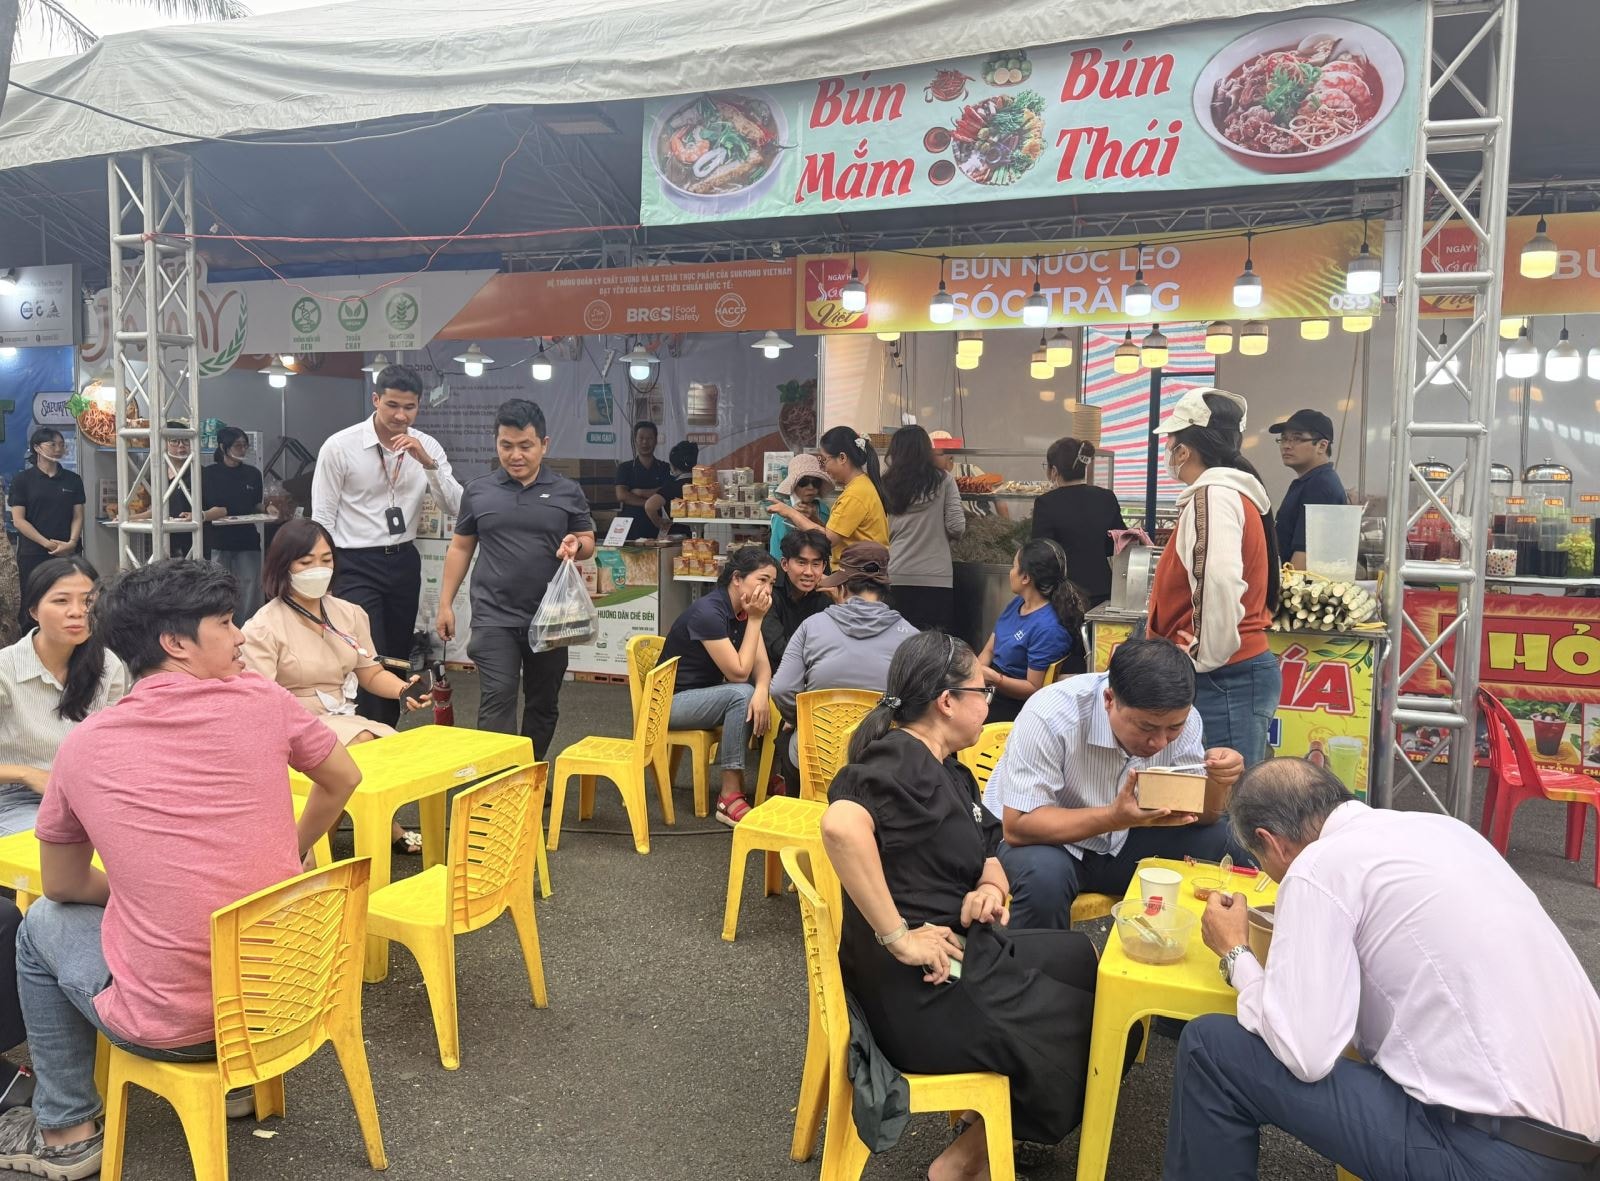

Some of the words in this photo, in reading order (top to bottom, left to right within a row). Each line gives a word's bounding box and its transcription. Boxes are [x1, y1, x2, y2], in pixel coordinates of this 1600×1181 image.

[1060, 39, 1175, 103] Bún
[810, 72, 907, 129] Bún
[1055, 118, 1183, 182] Thái
[795, 138, 915, 203] Mắm
[763, 267, 792, 276] VIETNAM
[951, 252, 1011, 280] BÚN
[675, 305, 696, 313] Food
[715, 306, 747, 316] HACCP
[817, 302, 855, 327] Việt
[952, 283, 1026, 320] SÓC
[1328, 292, 1371, 311] 039
[674, 313, 699, 322] Safety
[1278, 643, 1355, 715] ÍA
